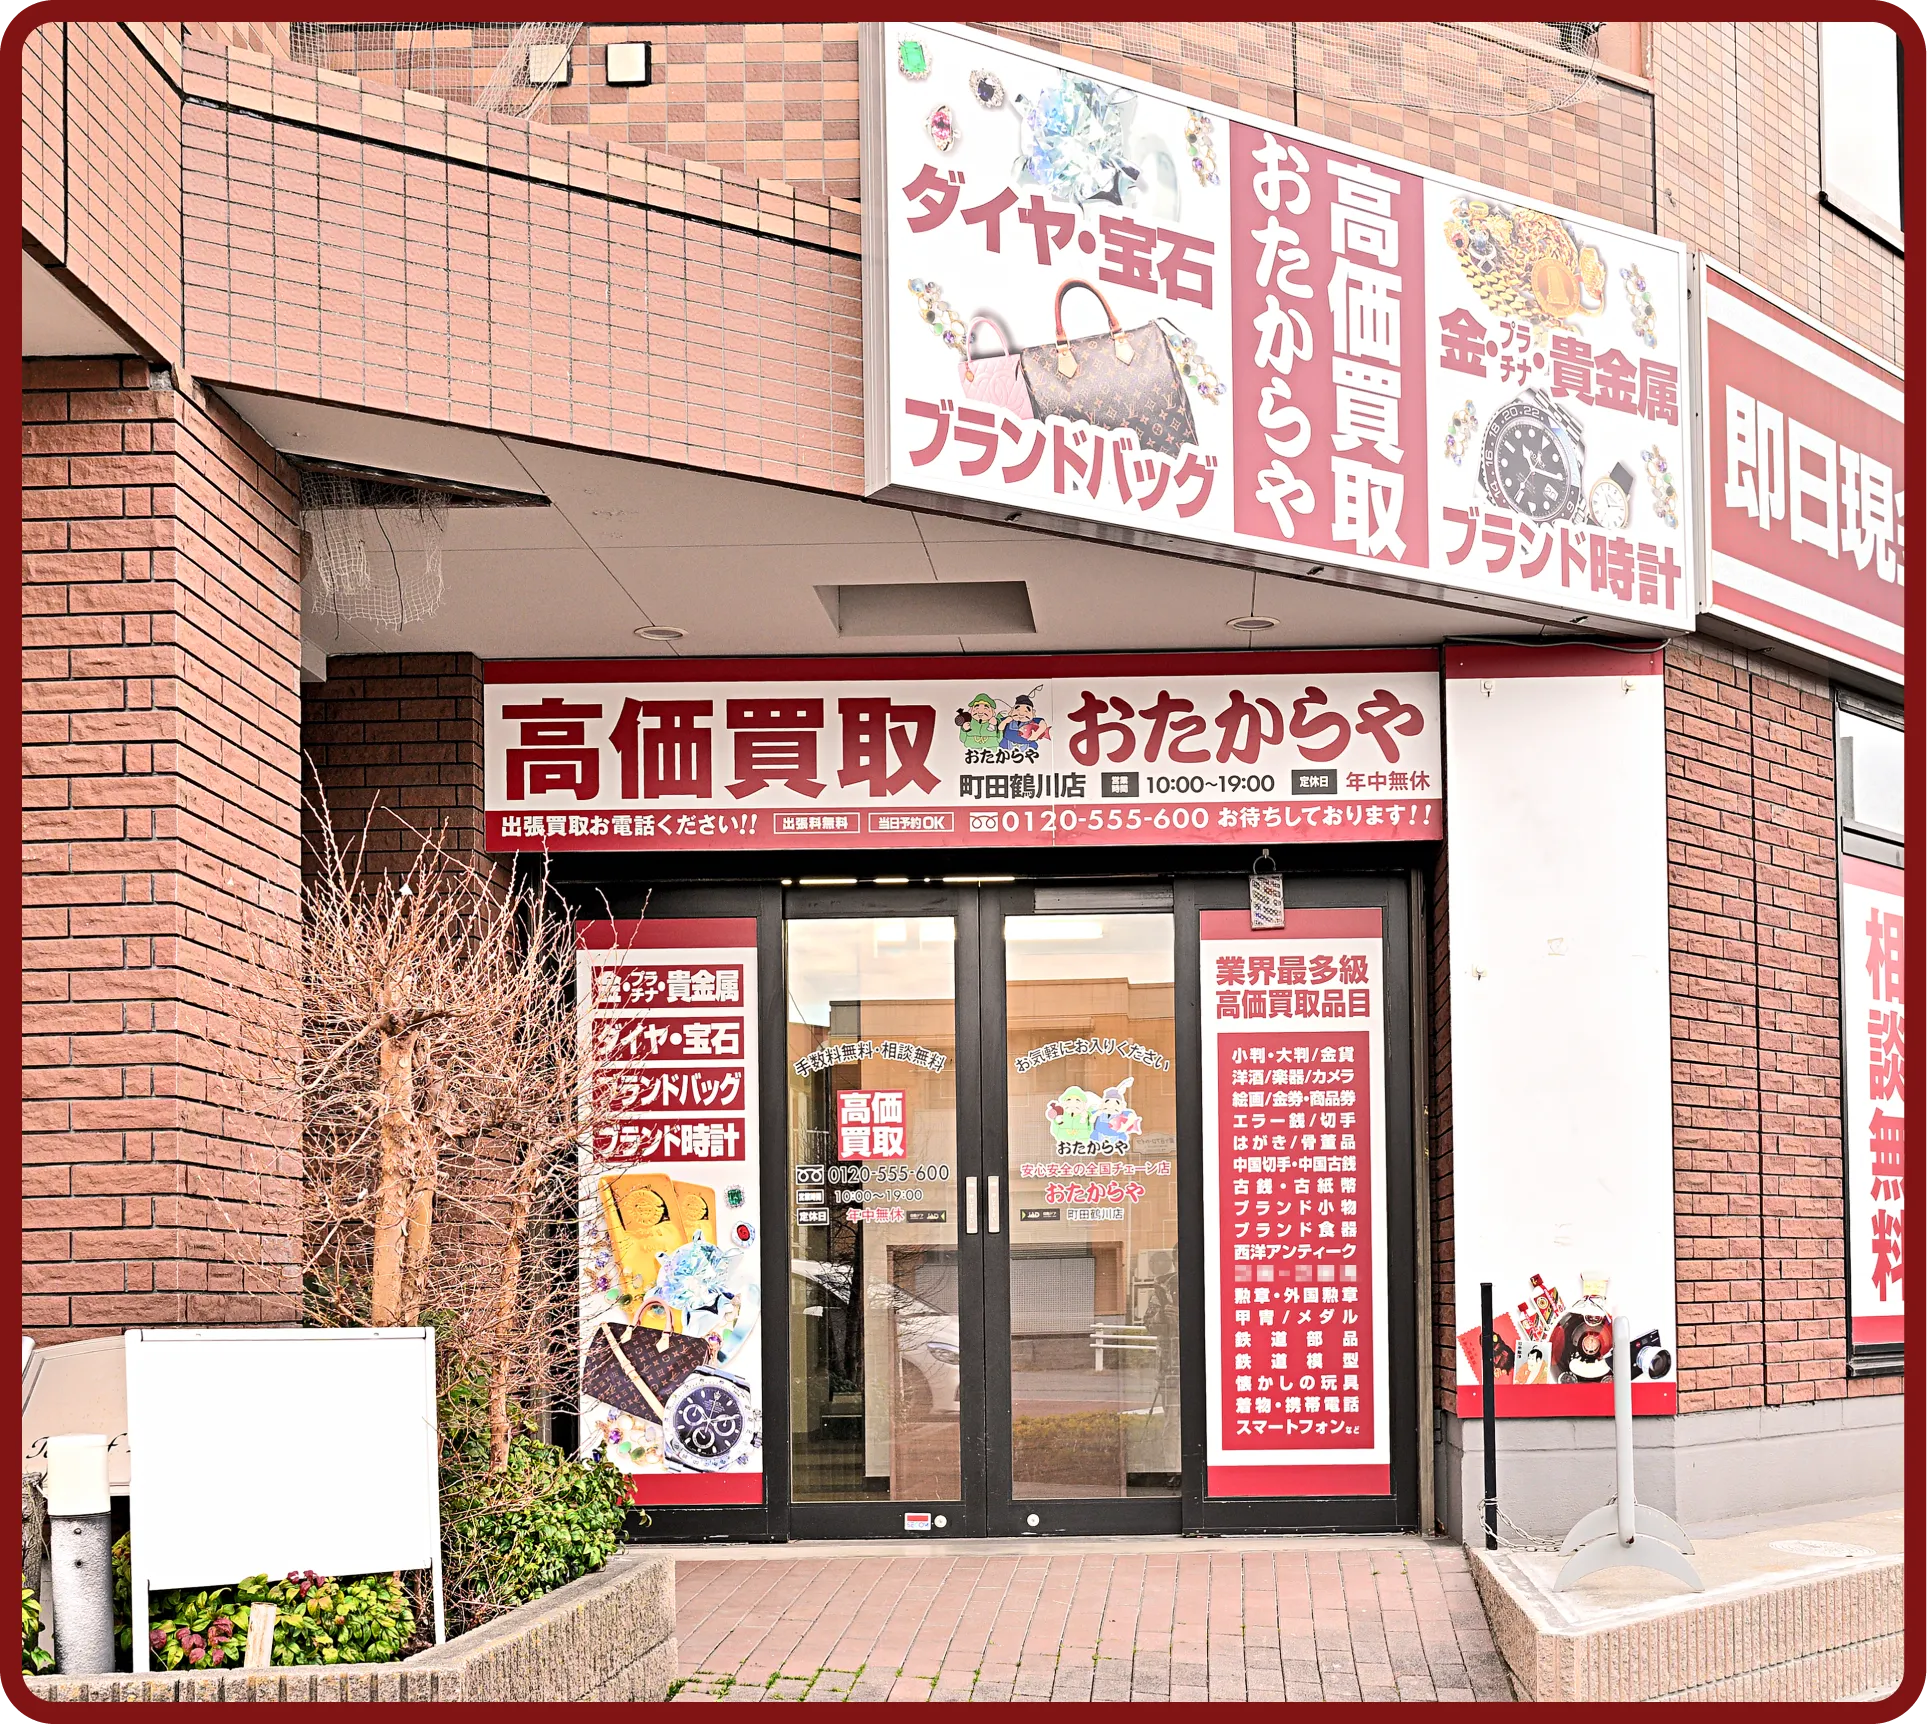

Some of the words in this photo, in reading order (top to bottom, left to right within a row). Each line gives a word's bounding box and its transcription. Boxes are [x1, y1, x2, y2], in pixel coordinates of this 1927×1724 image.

[902, 164, 1215, 311] ダイヤ・宝石
[1252, 132, 1316, 539] おたからや
[1327, 158, 1407, 562] 高価買取
[904, 397, 1219, 519] ブランドバッグ
[1725, 384, 1905, 588] 即日現
[1442, 505, 1682, 611] ブランド時計
[1067, 686, 1425, 766] おたからや
[502, 697, 941, 800] 高価買取
[964, 748, 1040, 765] おたからや
[959, 774, 1086, 799] 町田鶴川店
[1299, 776, 1330, 788] 定休日
[1346, 771, 1431, 792] 年中無休
[782, 817, 849, 830] 出張料無料
[877, 815, 945, 831] 当日予約OK
[1002, 809, 1209, 832] 0120-555-600
[1216, 955, 1369, 986] 業界最多級
[1216, 989, 1370, 1019] 高価買取品目
[596, 1022, 740, 1055] ダイヤ・宝石
[794, 1041, 947, 1078] 手数料無料・相談無料
[1015, 1038, 1170, 1073] お気軽にお入りください
[840, 1092, 903, 1124] 高価
[1866, 907, 1905, 1301] 相談無料
[597, 1122, 740, 1157] ブランド時計
[840, 1126, 904, 1158] 買取
[1057, 1140, 1129, 1156] おたからや
[828, 1165, 950, 1183] 0120-555-600
[1021, 1162, 1171, 1177] 安心安全の全国チェーン店
[1045, 1182, 1145, 1204] おたからや
[799, 1210, 827, 1222] 定休日
[847, 1208, 904, 1223] 年中無休
[1067, 1208, 1124, 1220] 町田鶴川店
[1234, 1199, 1357, 1216] ブランド小物
[1234, 1221, 1357, 1238] ブランド食器
[1234, 1243, 1357, 1260] 西洋アンティーク
[1235, 1330, 1358, 1348] 鉄道部品
[1235, 1352, 1359, 1370] 鉄道模型
[1235, 1374, 1359, 1392] 懐かしの玩具
